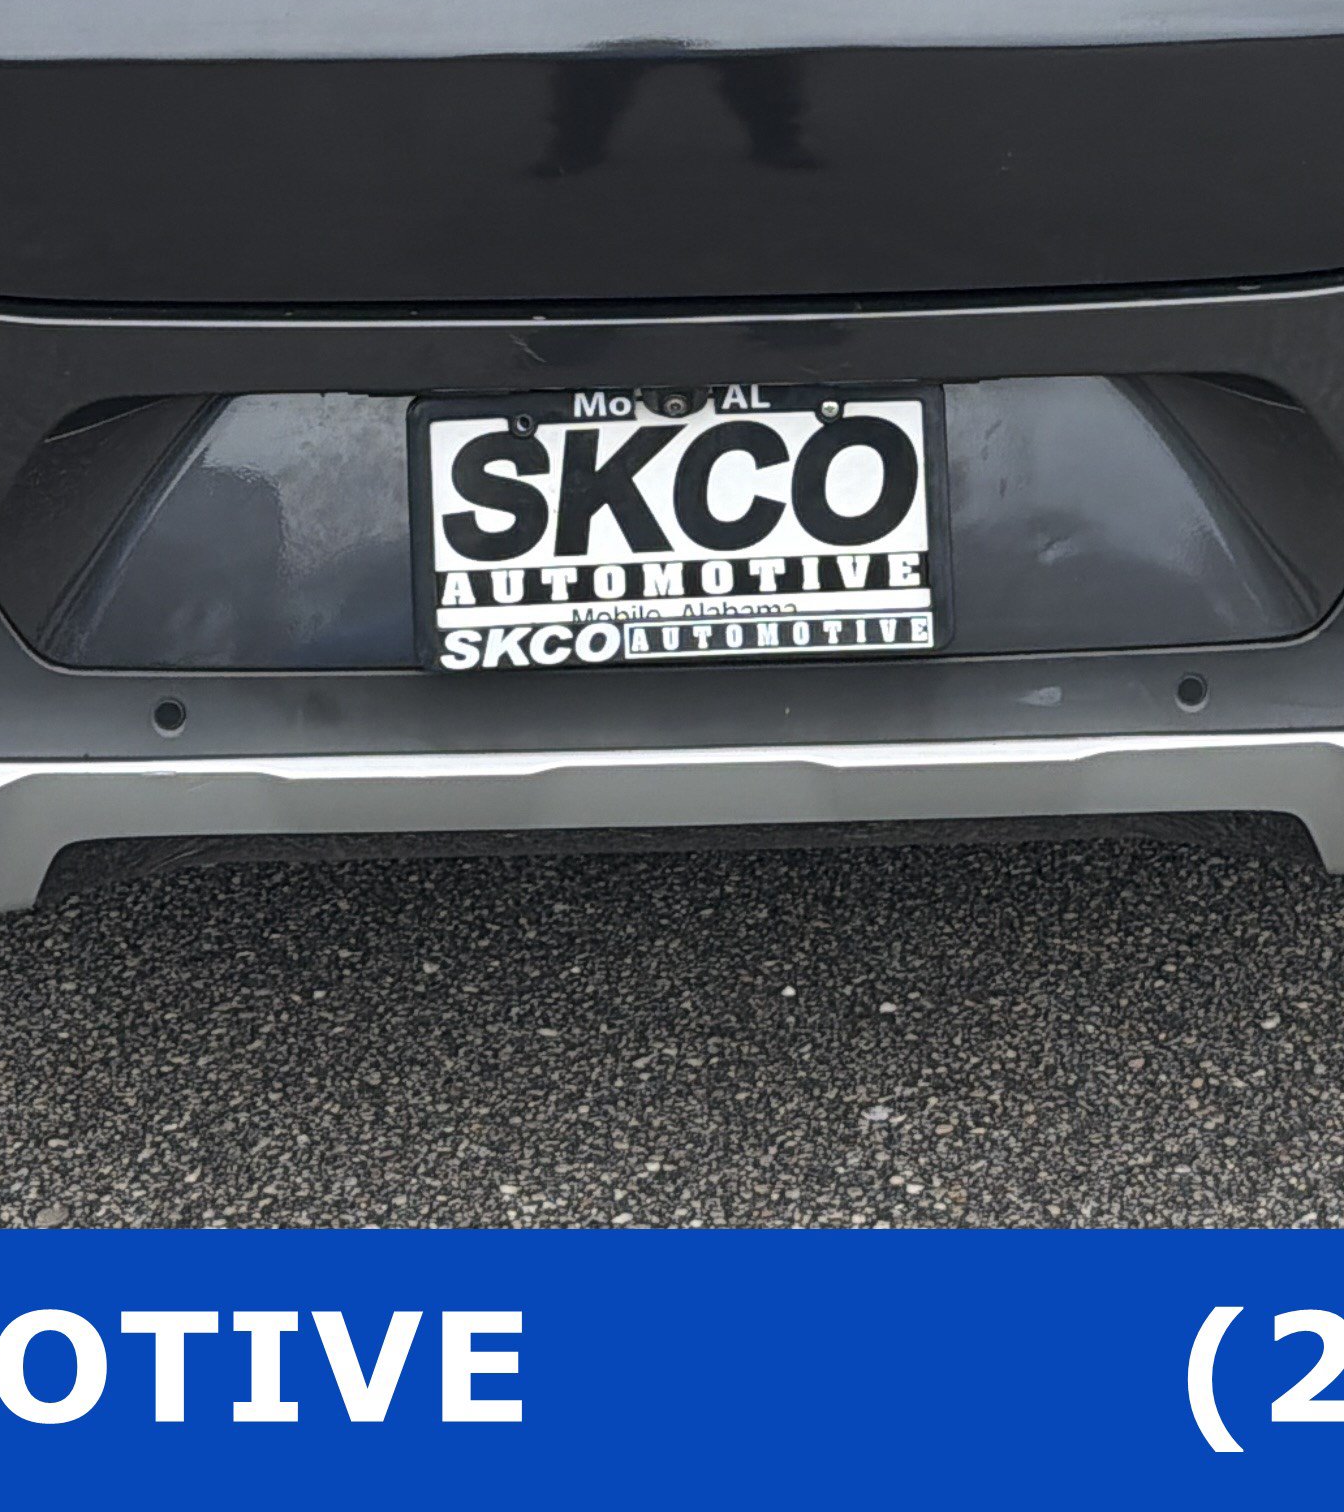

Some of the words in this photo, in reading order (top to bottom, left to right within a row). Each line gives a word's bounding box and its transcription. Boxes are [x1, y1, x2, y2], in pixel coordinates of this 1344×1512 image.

[721, 384, 771, 409] AL
[442, 420, 918, 562] SKCO
[441, 553, 921, 606] AUTOMOTIVE
[440, 622, 621, 671] SKCO
[630, 616, 930, 654] AUTOMOTIVE
